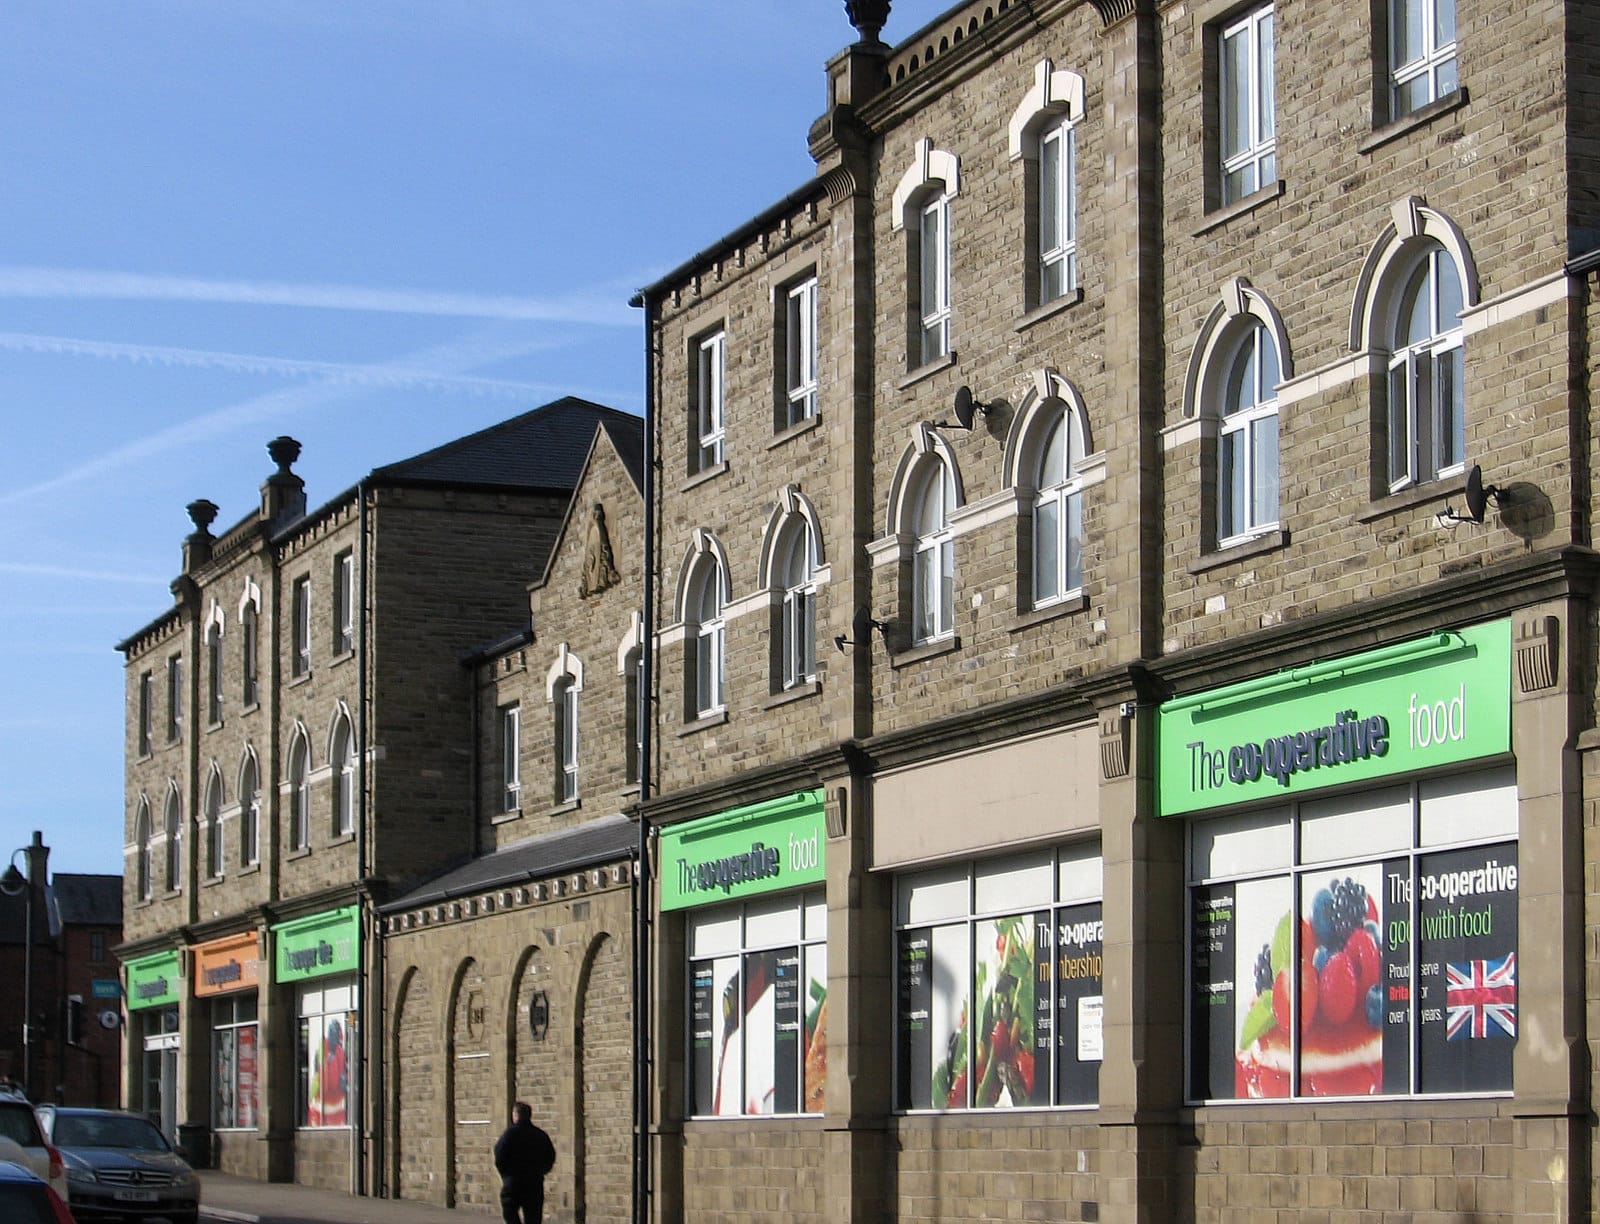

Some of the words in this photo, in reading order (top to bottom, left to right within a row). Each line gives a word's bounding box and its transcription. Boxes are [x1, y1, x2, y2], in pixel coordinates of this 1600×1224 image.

[1186, 741, 1225, 792] The
[1408, 683, 1466, 749] food
[676, 858, 698, 895] The
[788, 827, 818, 872] food
[1038, 923, 1050, 949] Th
[1426, 908, 1456, 940] with
[1458, 903, 1492, 938] food
